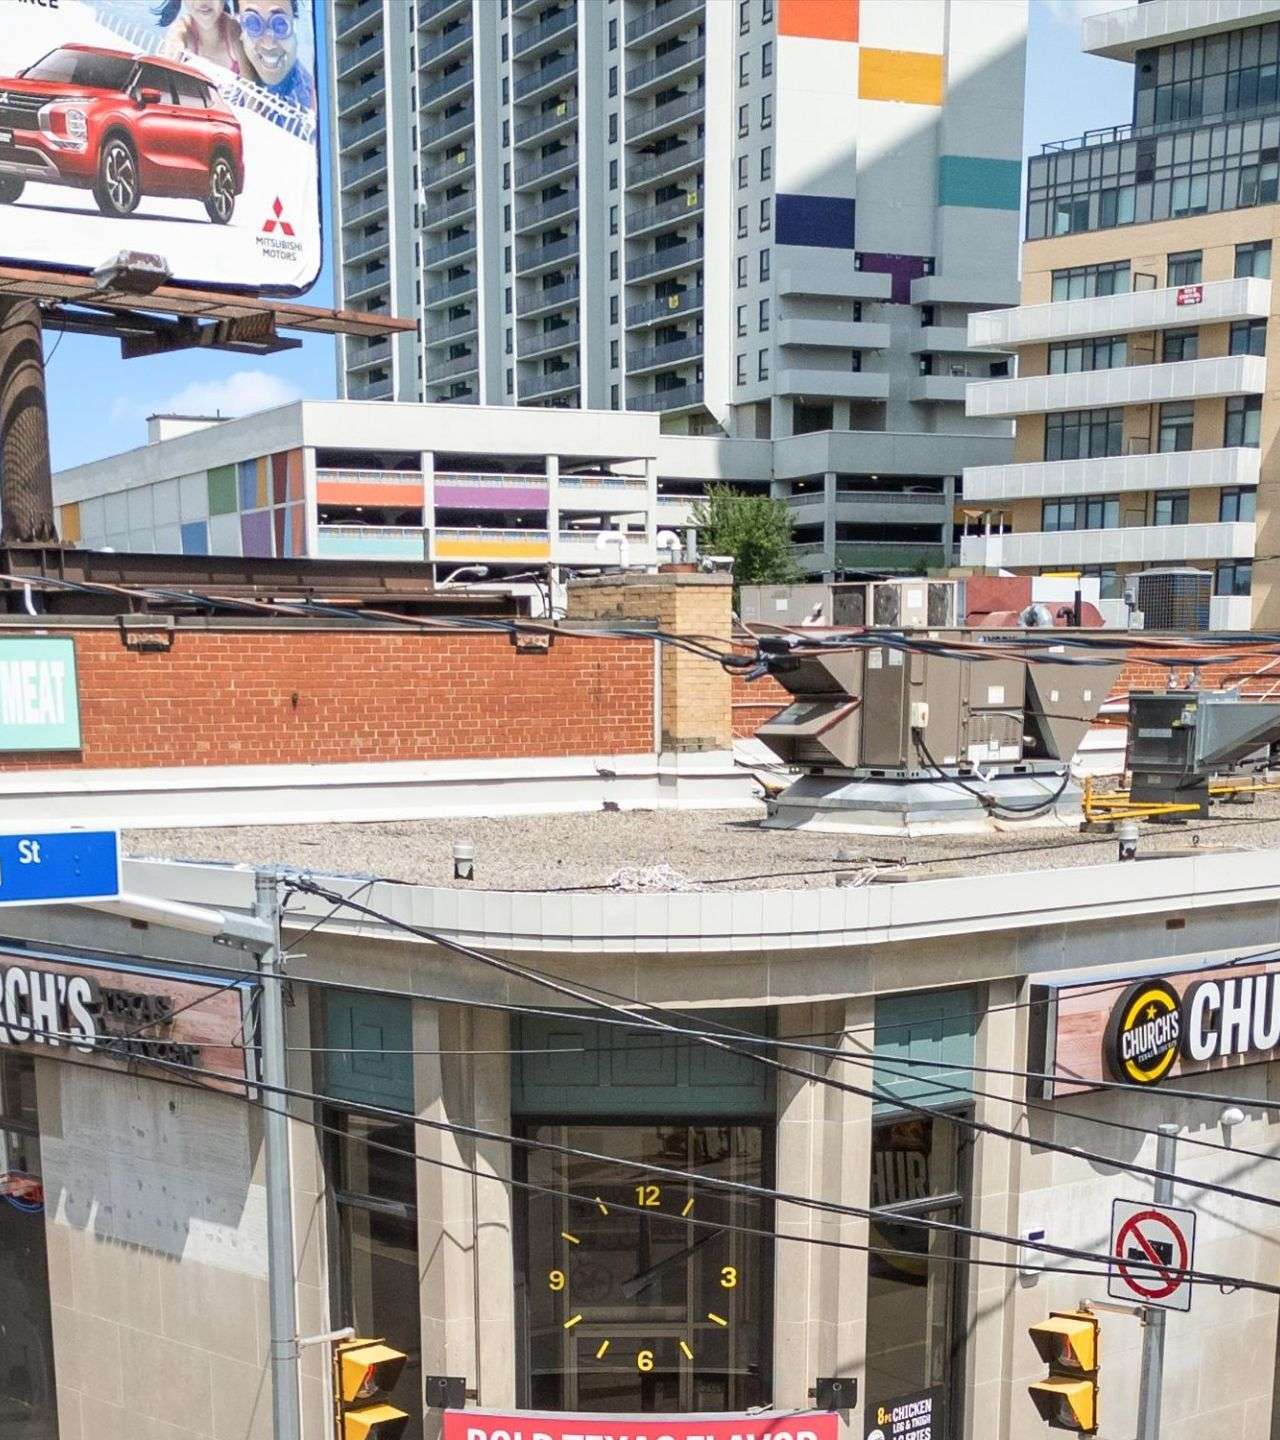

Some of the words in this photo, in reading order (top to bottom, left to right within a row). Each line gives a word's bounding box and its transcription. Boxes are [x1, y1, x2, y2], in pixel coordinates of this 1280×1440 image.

[255, 237, 303, 252] MITSUBISHI
[262, 249, 297, 261] MOTORS
[18, 839, 41, 864] St
[1122, 1010, 1180, 1060] CHURCH'S
[635, 1186, 661, 1206] 12
[548, 1270, 565, 1291] 9
[720, 1266, 737, 1288] 3
[637, 1350, 654, 1372] 6
[892, 1398, 932, 1422] CHICKEN
